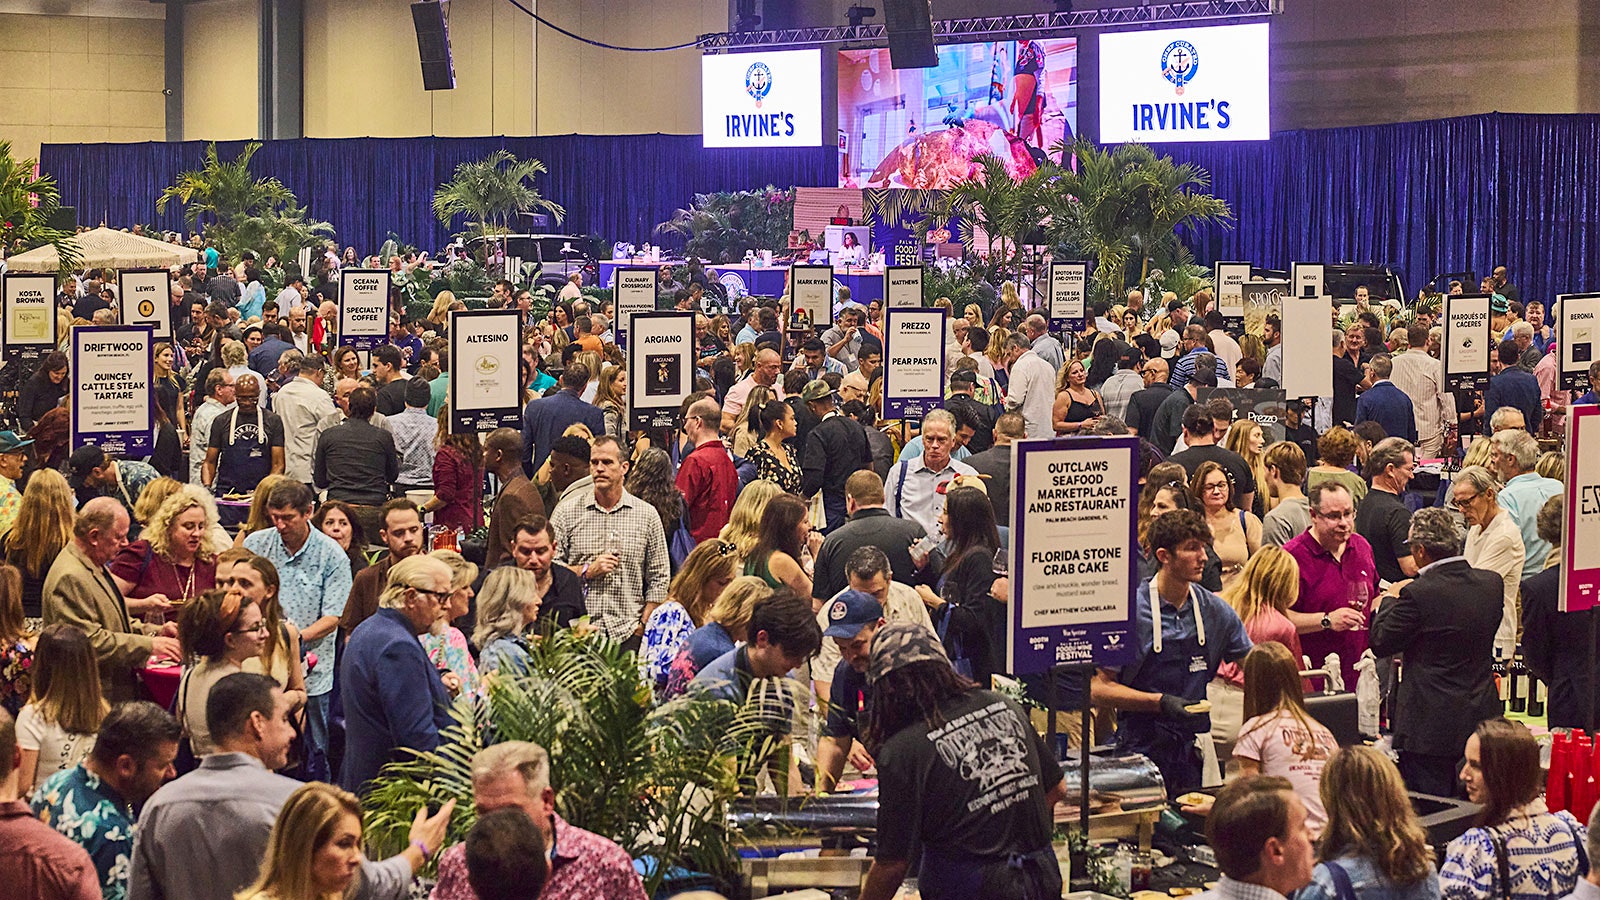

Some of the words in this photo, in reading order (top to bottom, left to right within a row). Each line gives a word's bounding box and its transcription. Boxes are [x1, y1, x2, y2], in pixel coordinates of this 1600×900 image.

[1132, 98, 1230, 130] IRVINE'S
[726, 110, 794, 137] IRVINE'S
[466, 334, 509, 343] ALTESINO
[645, 335, 682, 343] ARGIANO
[84, 343, 142, 352] DRIFTWOOD
[1248, 412, 1277, 423] Prezzo
[1048, 461, 1108, 473] OUTCLAWS
[1053, 474, 1103, 486] SEAFOOD
[1038, 486, 1118, 500] MARKETPLACE
[1029, 502, 1052, 513] AND
[1054, 498, 1126, 512] RESTAURANT
[1032, 550, 1080, 563] FLORIDA
[1083, 548, 1121, 560] STONE
[1043, 563, 1075, 576] CRAB
[1078, 561, 1109, 573] CAKE
[1056, 651, 1092, 661] FESTIVAL
